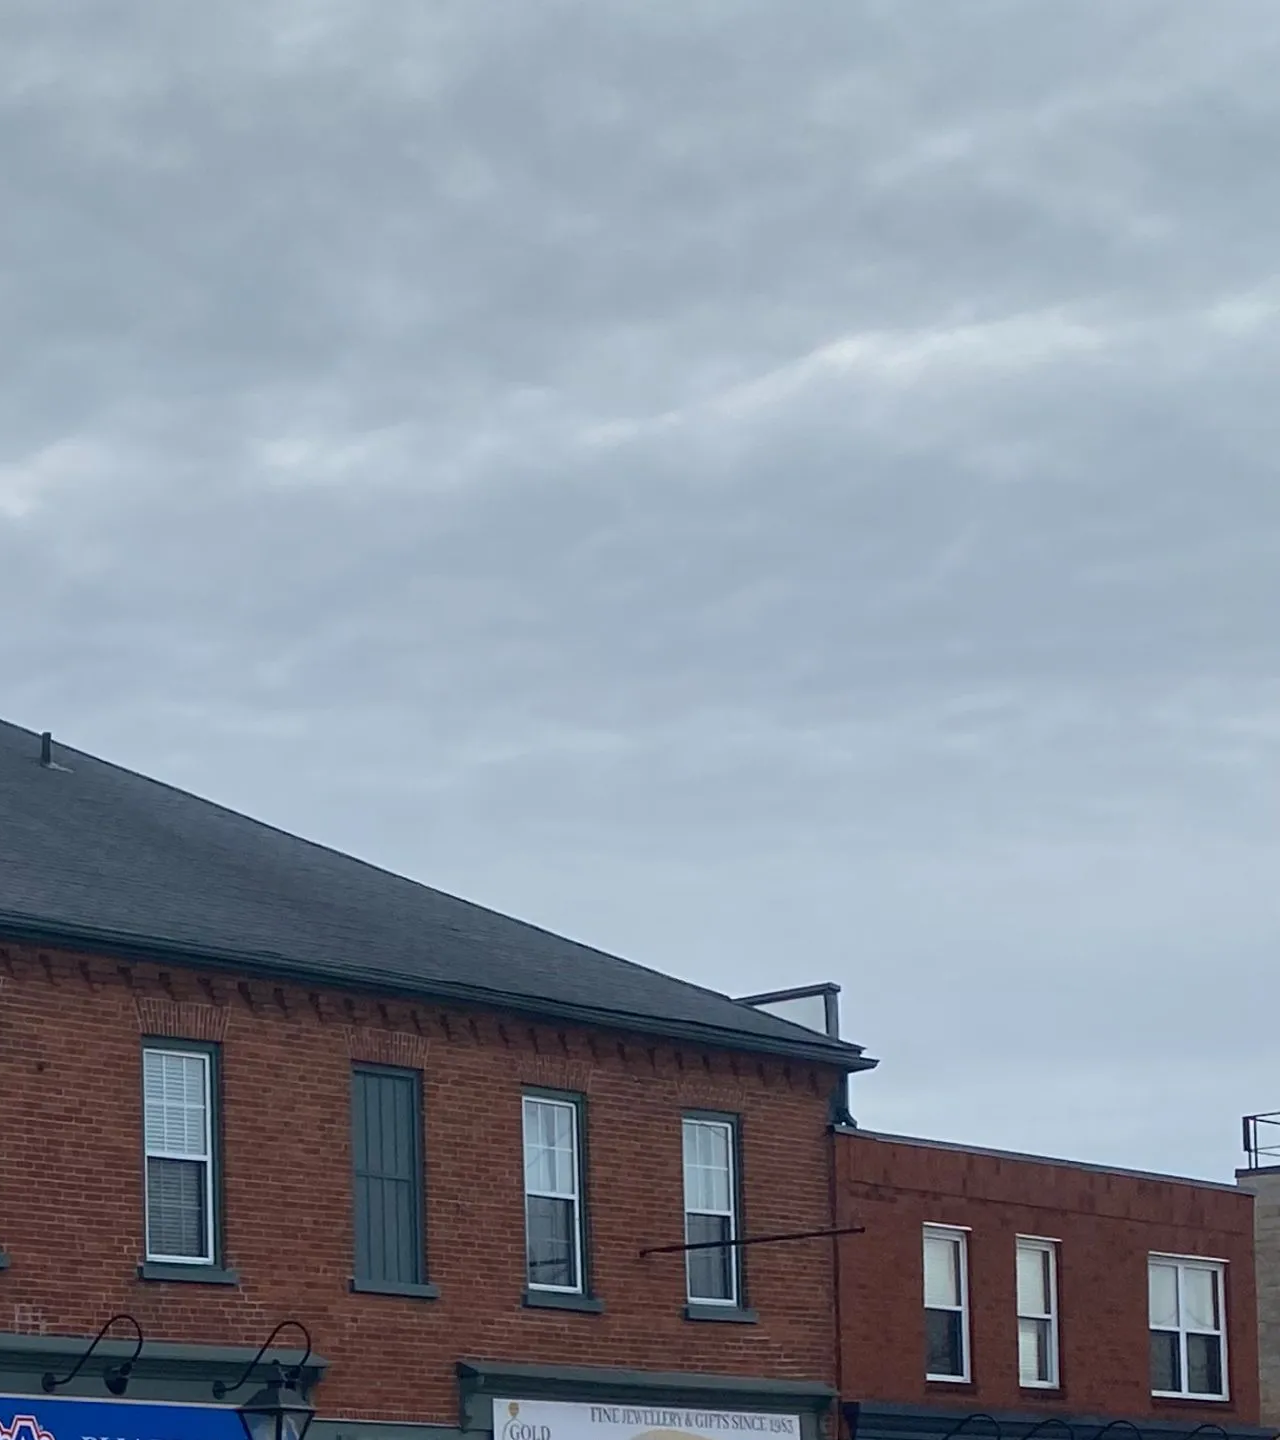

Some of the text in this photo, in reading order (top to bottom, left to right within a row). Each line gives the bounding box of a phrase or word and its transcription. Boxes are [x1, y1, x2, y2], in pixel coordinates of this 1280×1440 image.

[589, 1406, 621, 1424] FINE
[695, 1412, 730, 1430] GIFTS
[731, 1414, 769, 1432] SINCE
